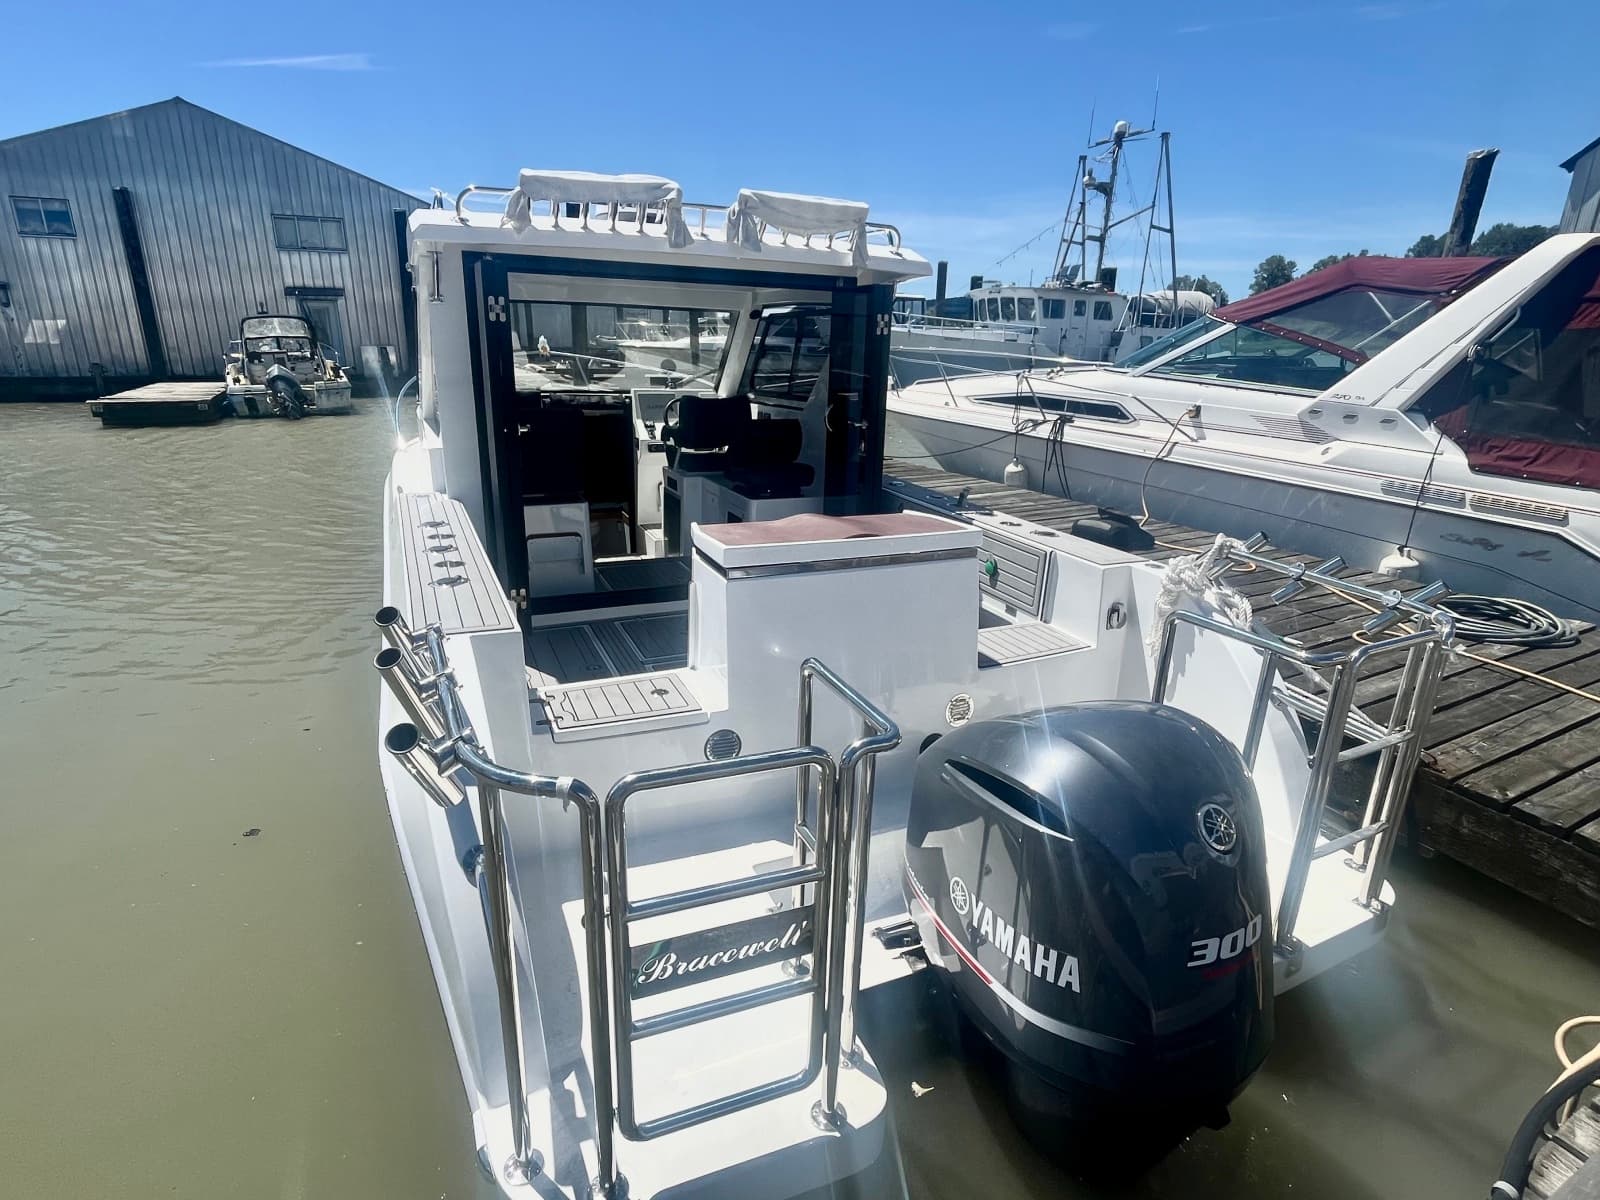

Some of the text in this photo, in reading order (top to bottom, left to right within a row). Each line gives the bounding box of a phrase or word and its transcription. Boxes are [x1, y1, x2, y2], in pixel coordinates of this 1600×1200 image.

[638, 920, 809, 985] Bracewell
[970, 892, 1081, 994] YAMAHA
[1187, 913, 1263, 968] 300
